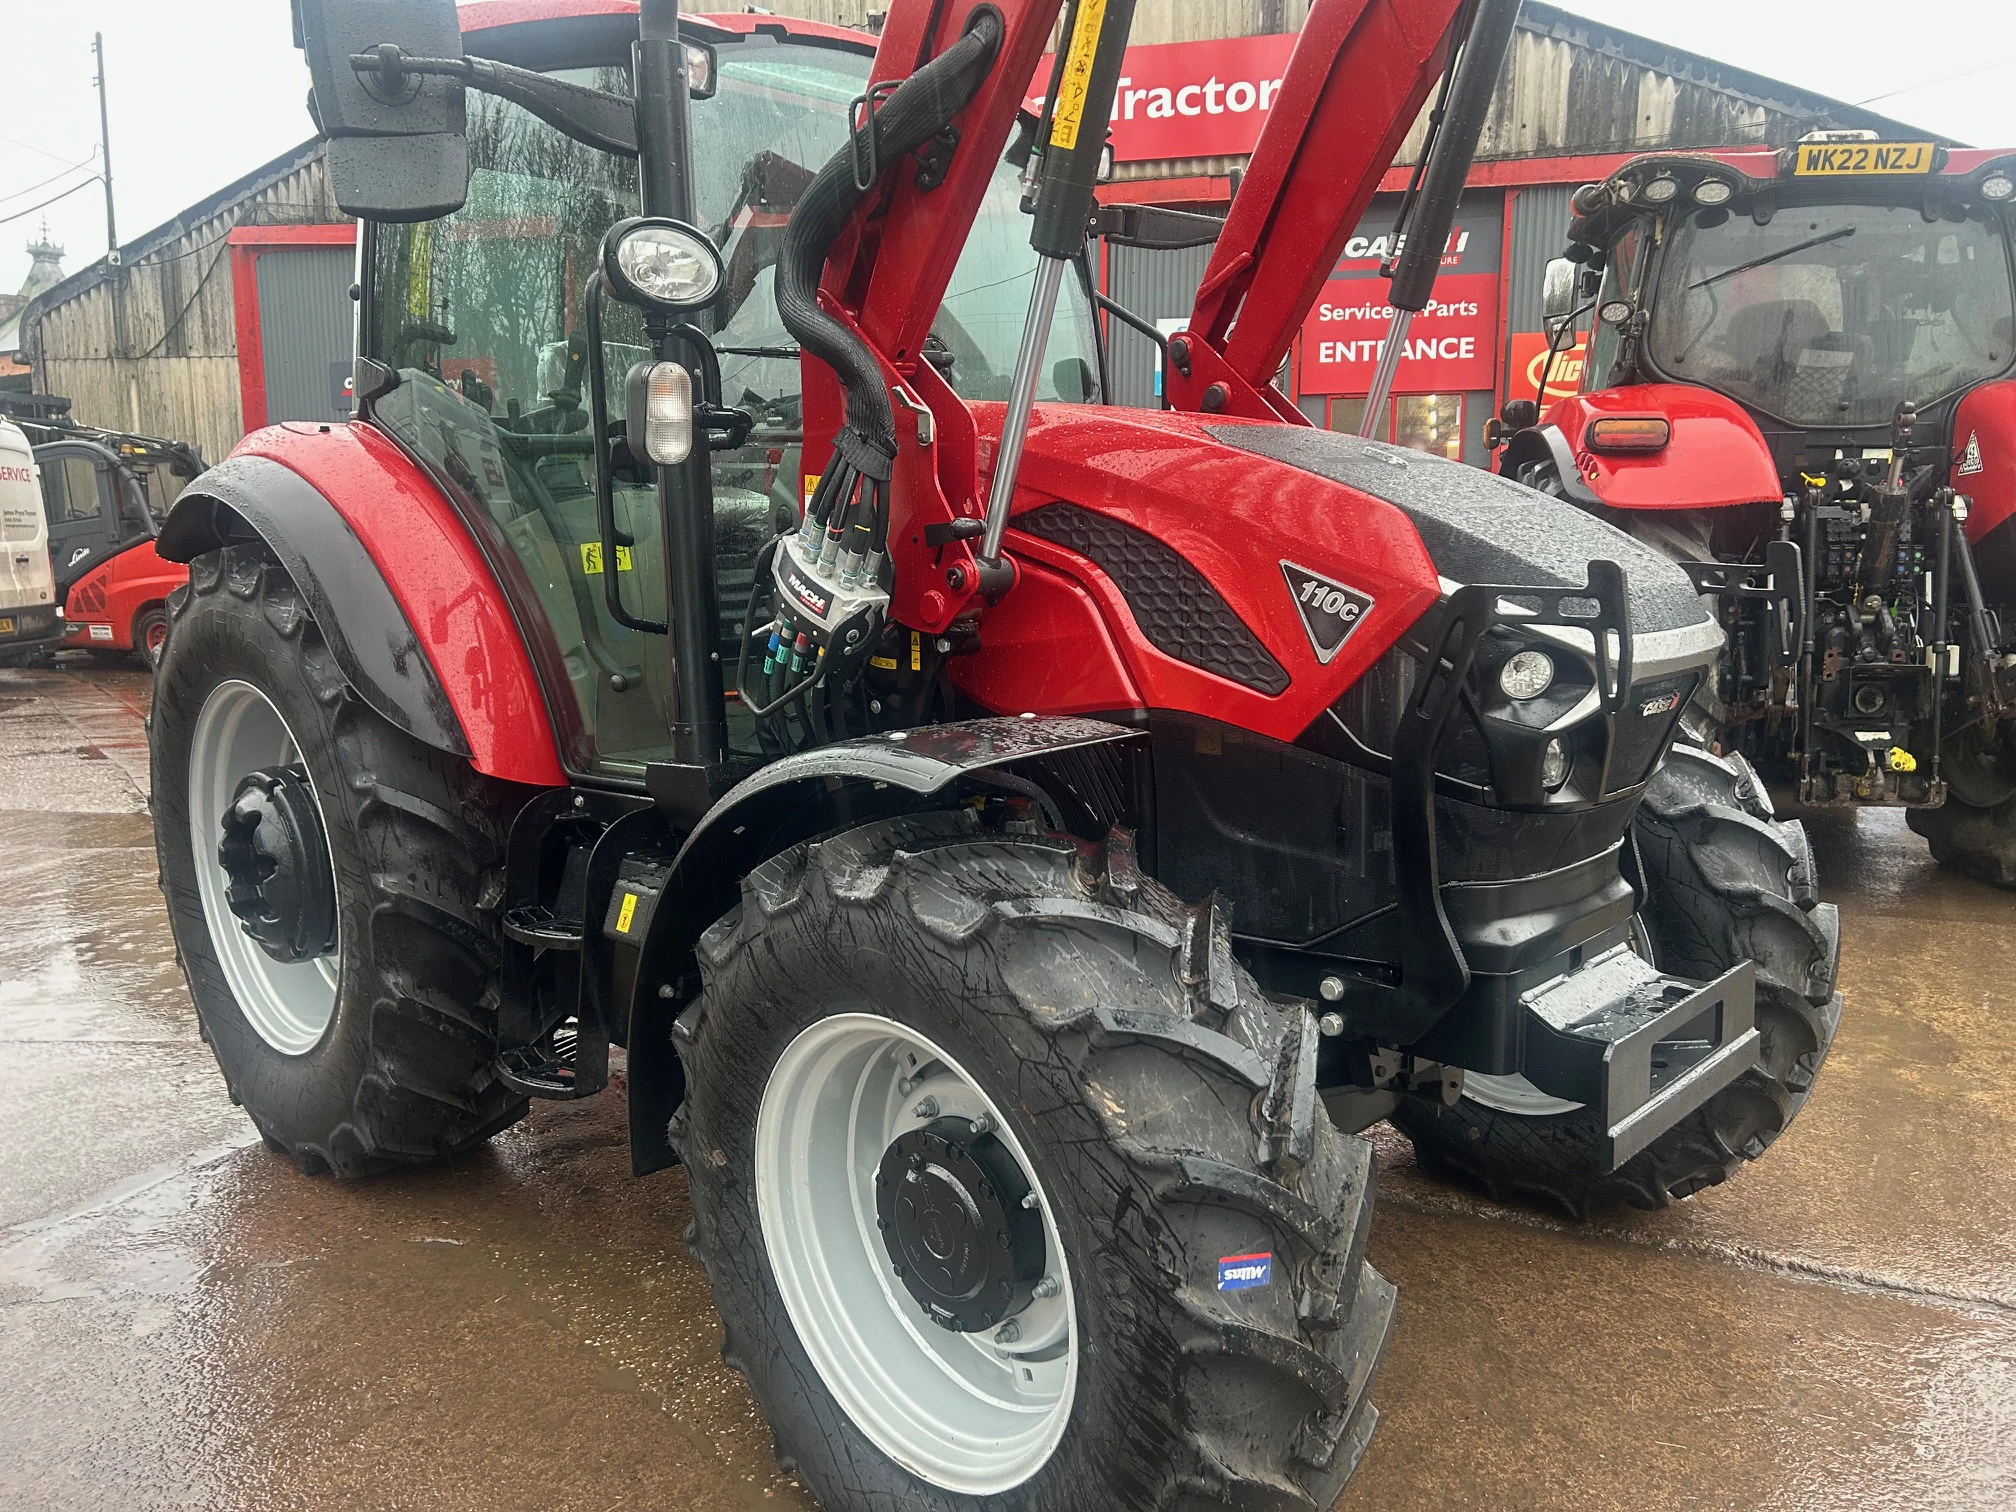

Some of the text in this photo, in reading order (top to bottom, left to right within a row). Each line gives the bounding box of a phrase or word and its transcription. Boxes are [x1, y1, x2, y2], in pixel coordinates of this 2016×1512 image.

[1806, 147, 1922, 171] WK22 NZJ
[1319, 302, 1394, 321] Service
[1422, 299, 1478, 318] Parts
[0, 466, 31, 482] ERVICE
[67, 547, 91, 567] Linde
[1224, 1264, 1267, 1281] Mitas
